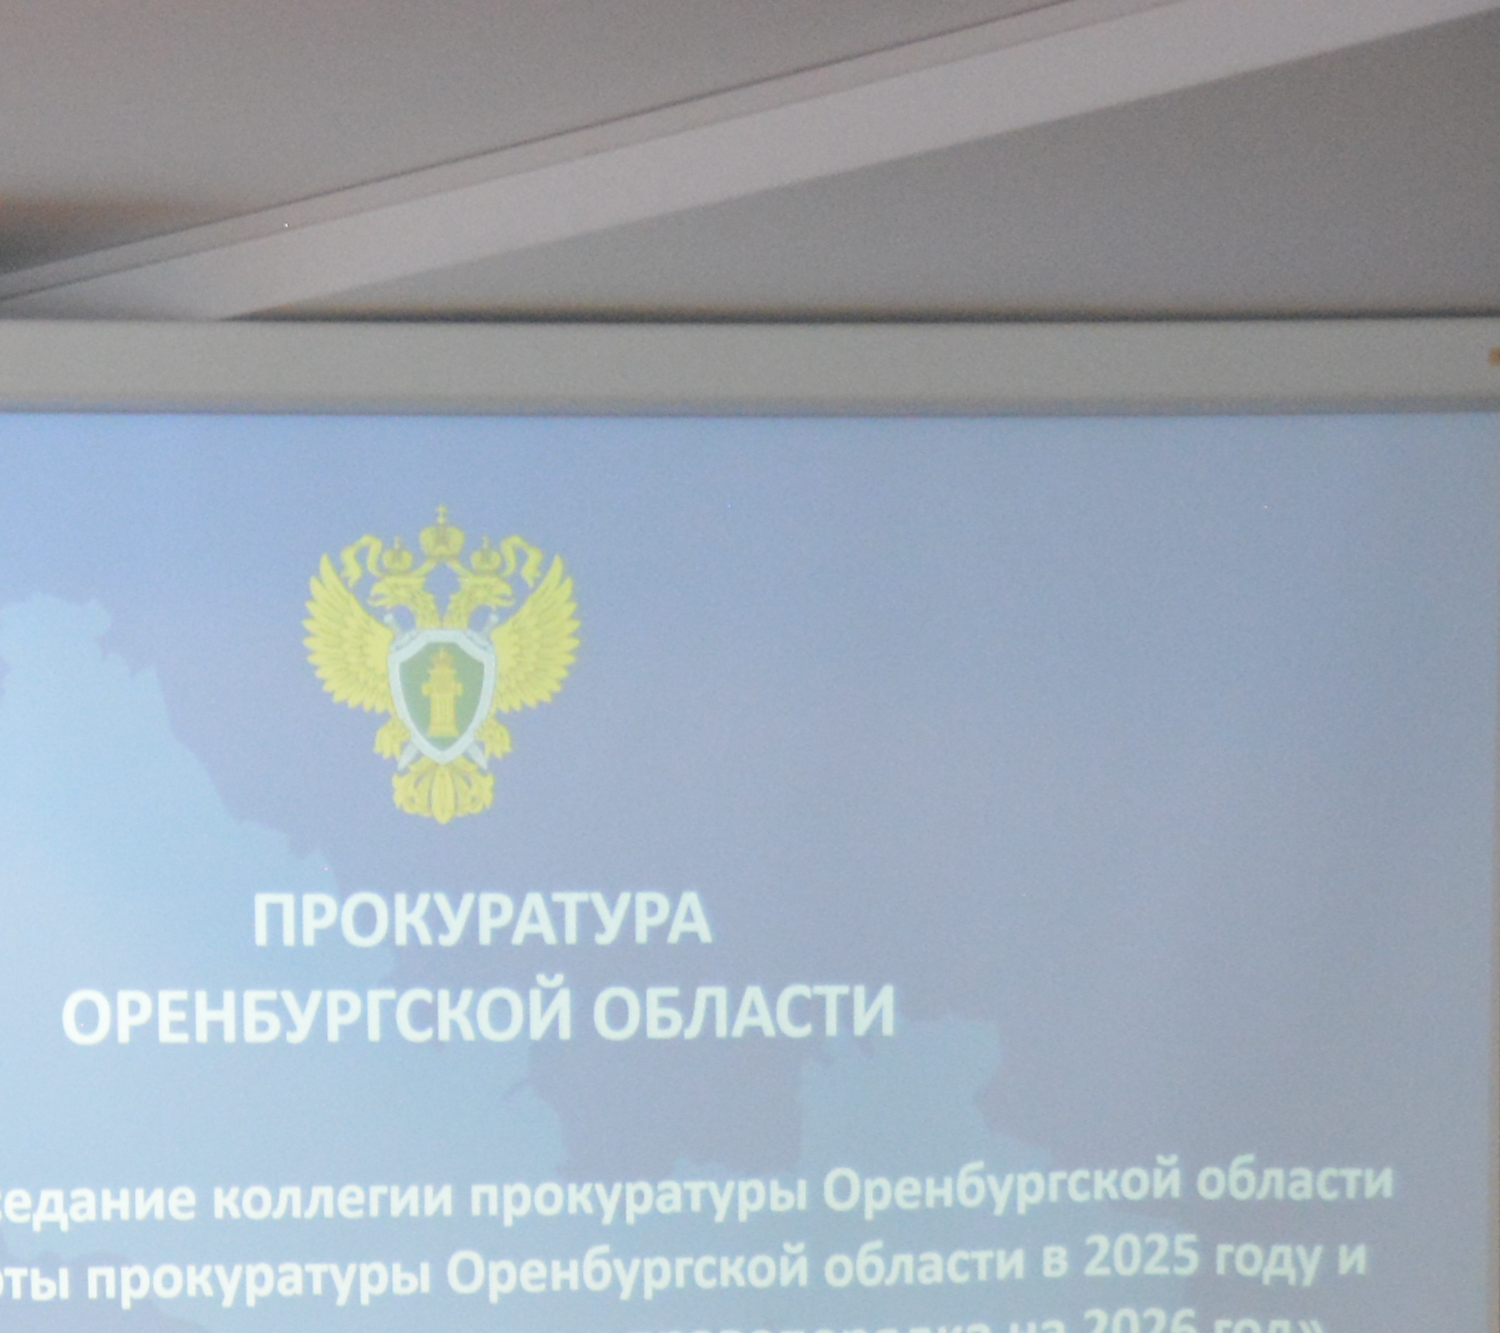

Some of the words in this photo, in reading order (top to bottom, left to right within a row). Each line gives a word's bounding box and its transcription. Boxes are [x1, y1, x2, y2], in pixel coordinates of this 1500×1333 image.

[254, 891, 713, 948] ПРОКУРАТУРА
[62, 974, 570, 1045] ОРЕНБУРГСКОЙ
[593, 984, 896, 1043] ОБЛАСТИ
[214, 1183, 453, 1220] коллегии
[471, 1177, 806, 1227] прокуратуры
[824, 1155, 1180, 1221] Оренбургской
[1197, 1154, 1393, 1200] области
[88, 1260, 430, 1309] прокуратуры
[447, 1242, 807, 1303] Оренбургской
[824, 1240, 1024, 1287] области
[1043, 1245, 1068, 1278] в
[1084, 1233, 1199, 1277] 2025
[1216, 1242, 1322, 1286] году
[1339, 1243, 1367, 1275] и
